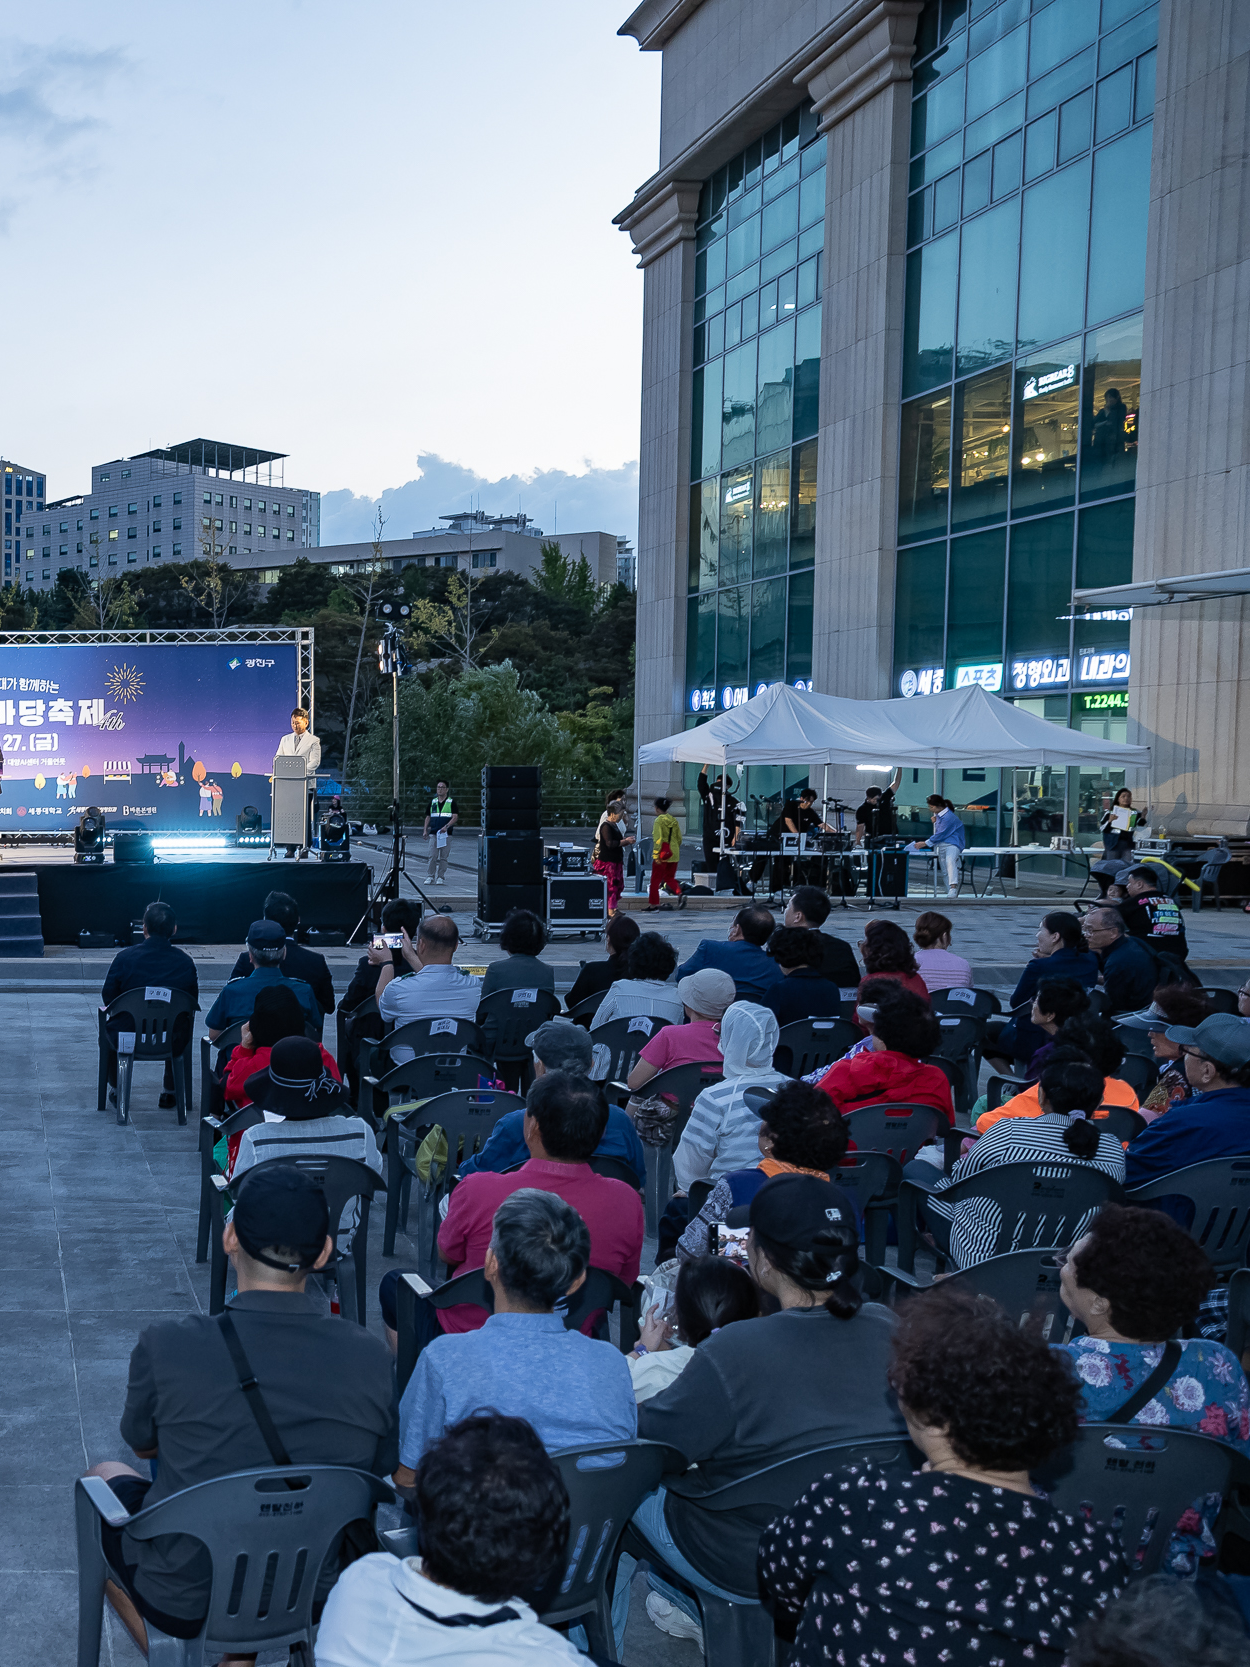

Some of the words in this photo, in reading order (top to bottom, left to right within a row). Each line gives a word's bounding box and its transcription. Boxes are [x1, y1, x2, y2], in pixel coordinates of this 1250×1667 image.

[245, 658, 275, 668] 광진구
[917, 668, 945, 696] 세종
[1012, 657, 1071, 689] 정형외과
[18, 677, 60, 695] 함께하는
[29, 733, 59, 752] (금)
[28, 806, 63, 815] 세종대학교
